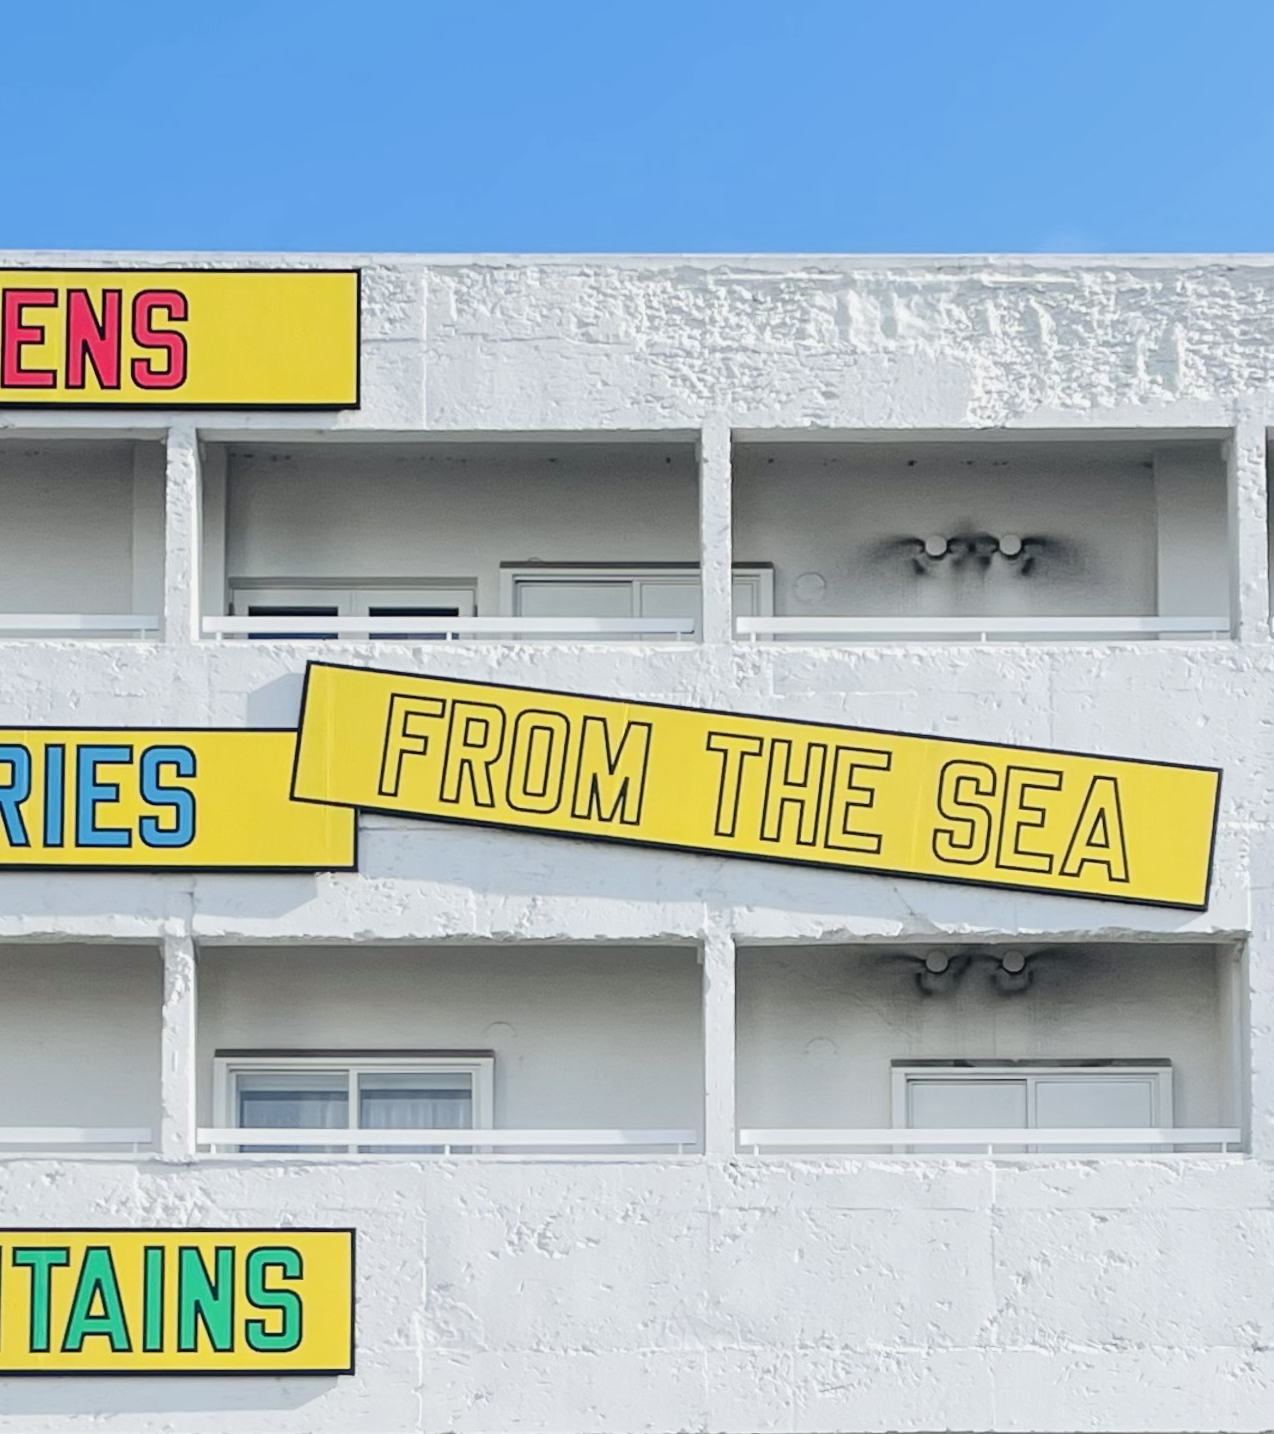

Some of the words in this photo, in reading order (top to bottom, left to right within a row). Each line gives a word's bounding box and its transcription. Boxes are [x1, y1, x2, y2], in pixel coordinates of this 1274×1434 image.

[378, 692, 652, 826] FROM
[703, 731, 894, 857] THE
[929, 757, 1130, 885] SEA
